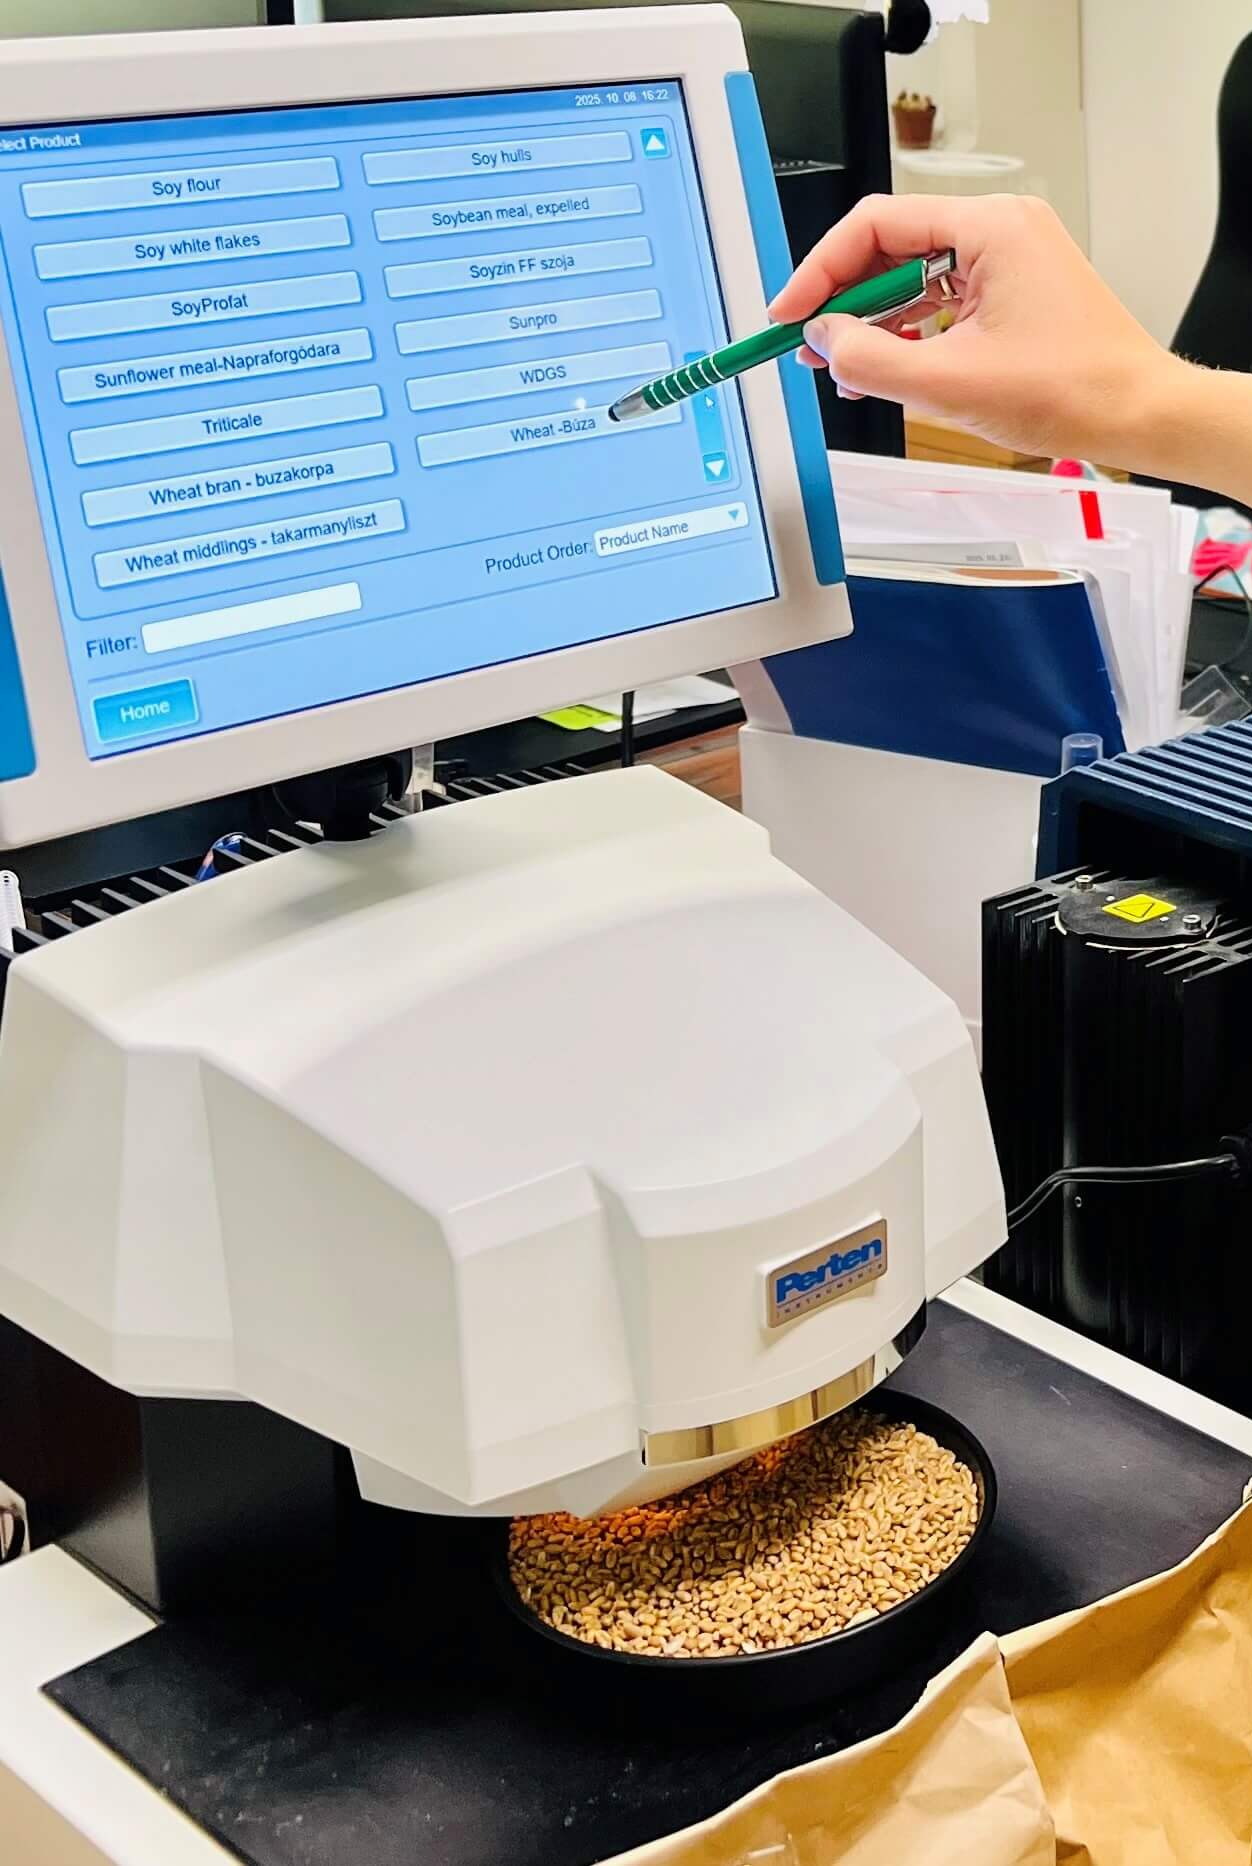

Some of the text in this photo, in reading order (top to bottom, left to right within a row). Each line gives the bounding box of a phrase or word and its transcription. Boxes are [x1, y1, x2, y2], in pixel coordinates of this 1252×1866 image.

[29, 133, 81, 149] Product
[471, 148, 532, 168] Soy hulls
[152, 177, 221, 198] Soy flour
[432, 198, 590, 228] Soybean meal, expelled
[135, 233, 260, 261] Soy white flakes
[469, 261, 515, 280] Soyzin
[519, 258, 536, 273] FF
[171, 294, 249, 319] SoyProfat
[509, 313, 557, 331] Sunpro
[95, 366, 174, 389] Sunflower
[520, 366, 567, 385] WDGS
[202, 413, 263, 435] Triticale
[510, 425, 554, 442] Wheat
[149, 484, 201, 505] Wheat
[206, 477, 241, 495] bran
[255, 463, 334, 487] buzakorpa
[125, 551, 178, 572] Wheat
[183, 536, 257, 563] middlings
[271, 513, 378, 545] takarmanyliszt
[485, 551, 544, 574] Product
[599, 529, 648, 550] Product
[651, 521, 689, 539] Name
[86, 636, 138, 658] Filter:
[120, 700, 170, 723] Home
[776, 1239, 882, 1304] Perten
